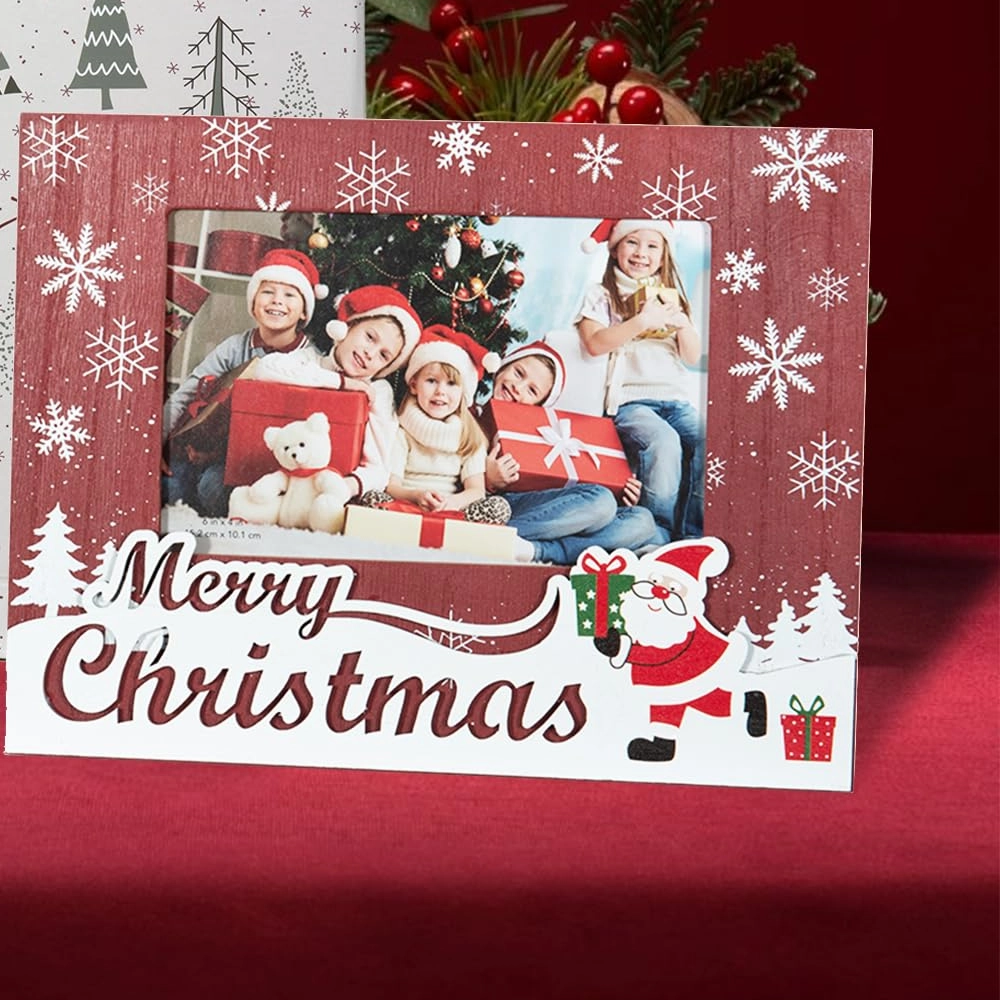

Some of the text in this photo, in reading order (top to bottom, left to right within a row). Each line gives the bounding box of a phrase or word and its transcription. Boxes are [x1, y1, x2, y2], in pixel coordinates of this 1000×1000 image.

[228, 530, 245, 539] 10.1
[93, 539, 343, 640] Merry
[42, 624, 588, 742] Christmas
